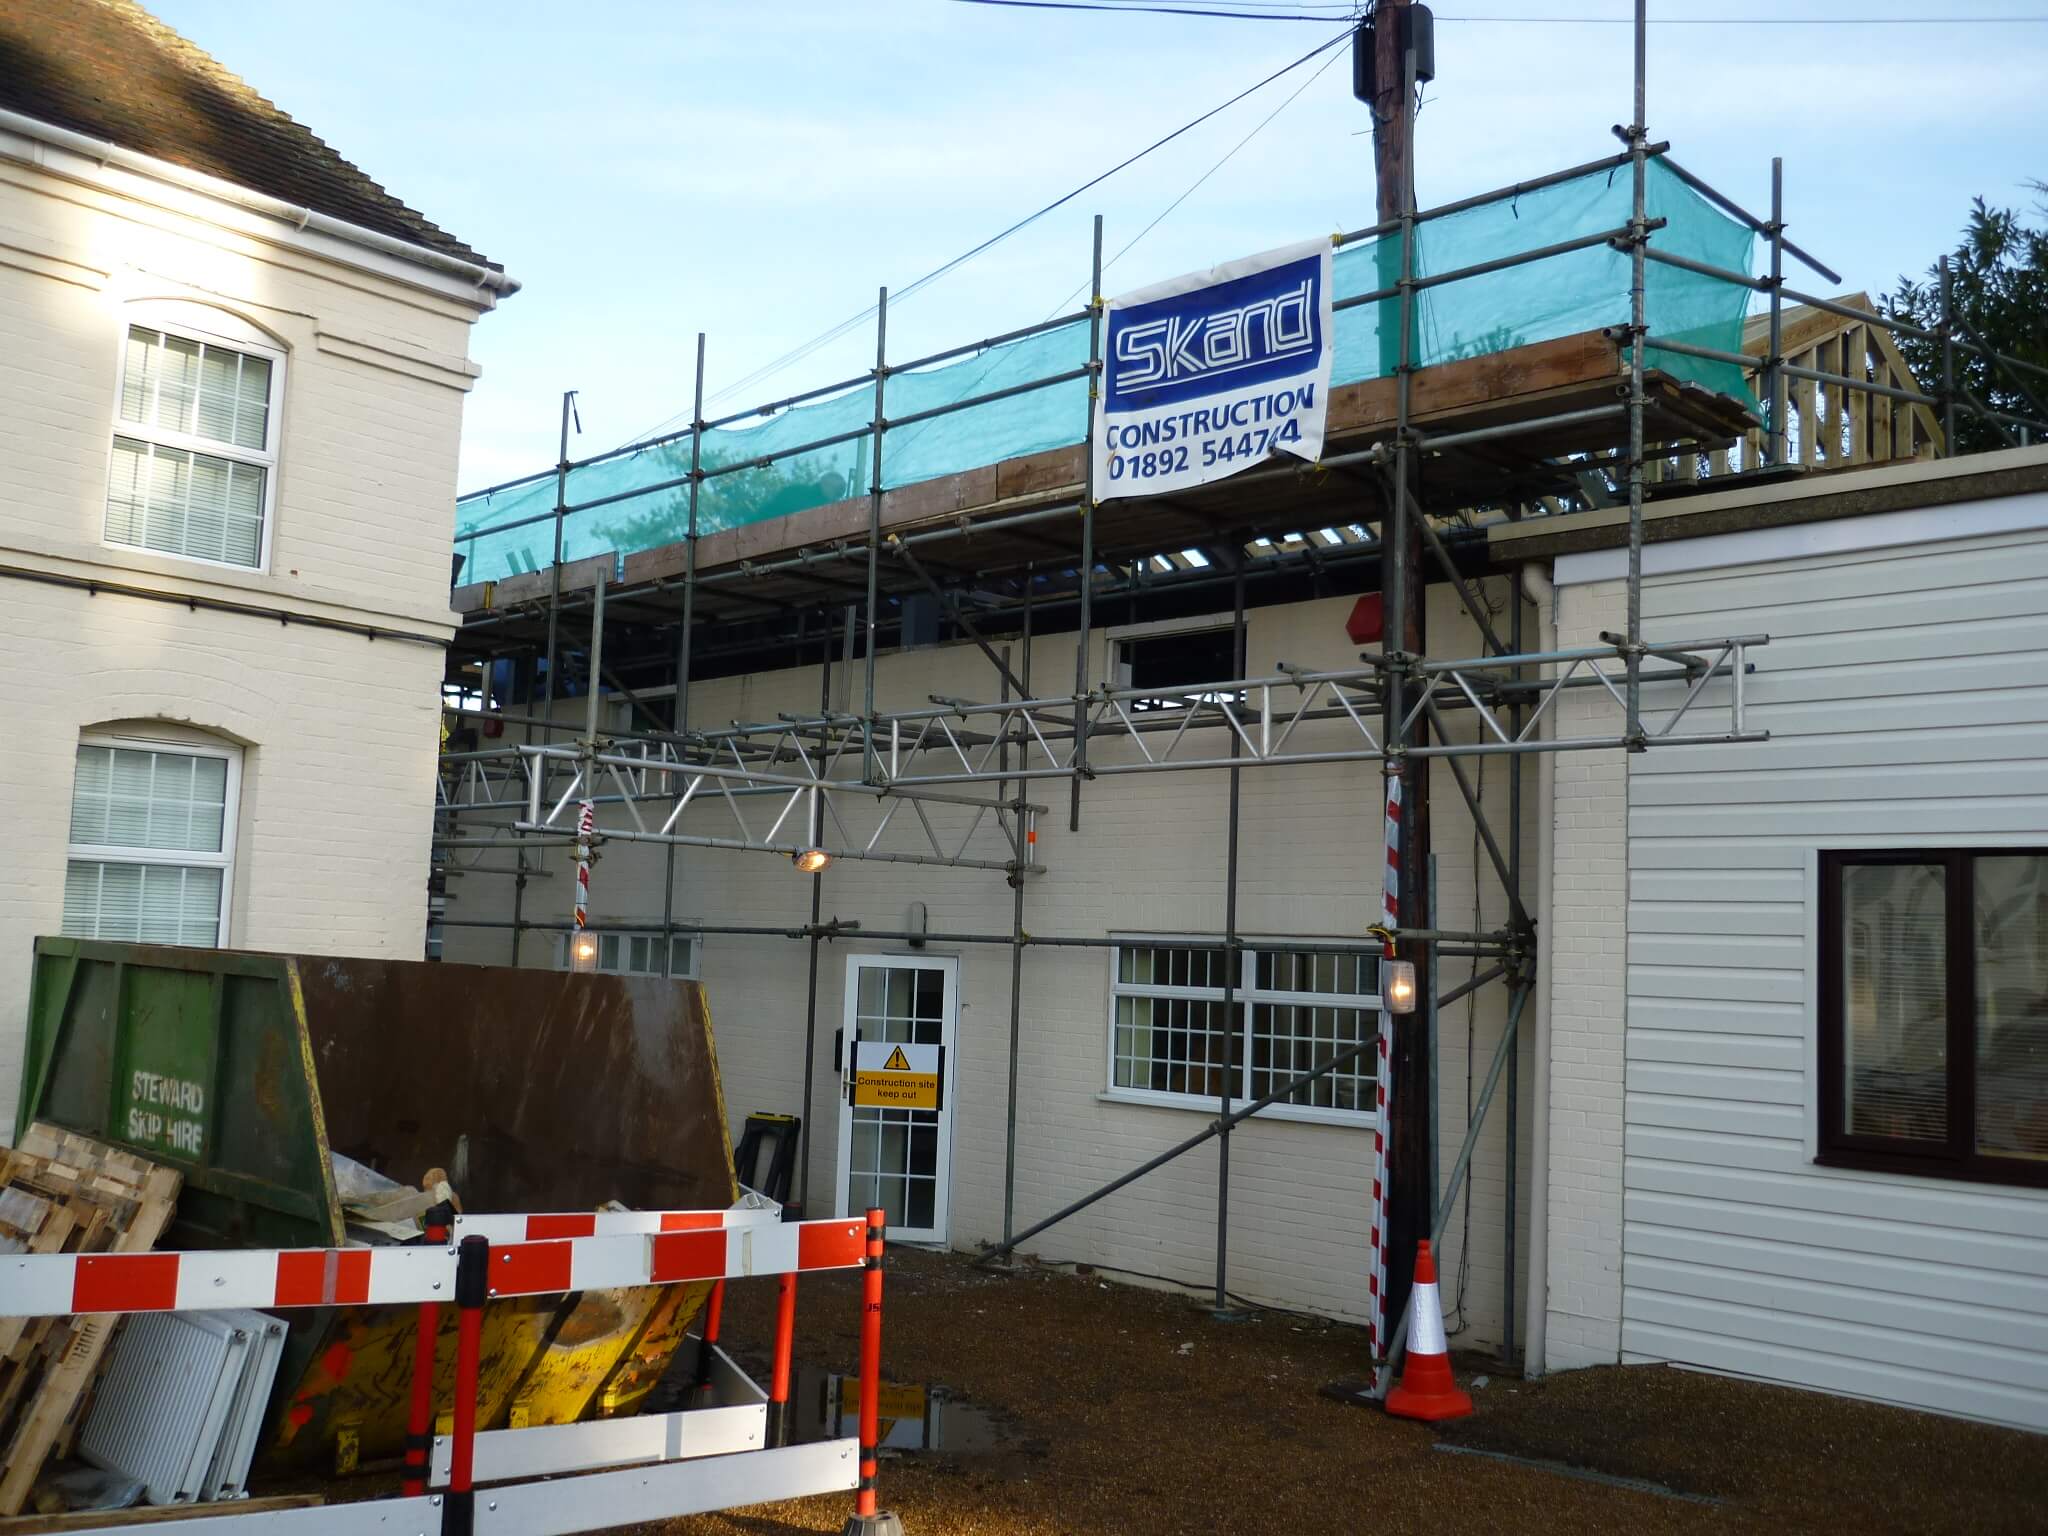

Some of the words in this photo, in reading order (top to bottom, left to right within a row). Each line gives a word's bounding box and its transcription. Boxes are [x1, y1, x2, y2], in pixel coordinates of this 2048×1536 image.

[1106, 383, 1315, 450] CONSTRUCTION
[1109, 446, 1189, 480] 01892
[132, 1070, 204, 1114] STEWARD
[857, 1076, 916, 1088] Construction
[918, 1079, 935, 1089] site
[877, 1089, 900, 1100] keep
[902, 1091, 917, 1099] out
[128, 1107, 162, 1142] SKIP
[166, 1117, 204, 1155] HIRE
